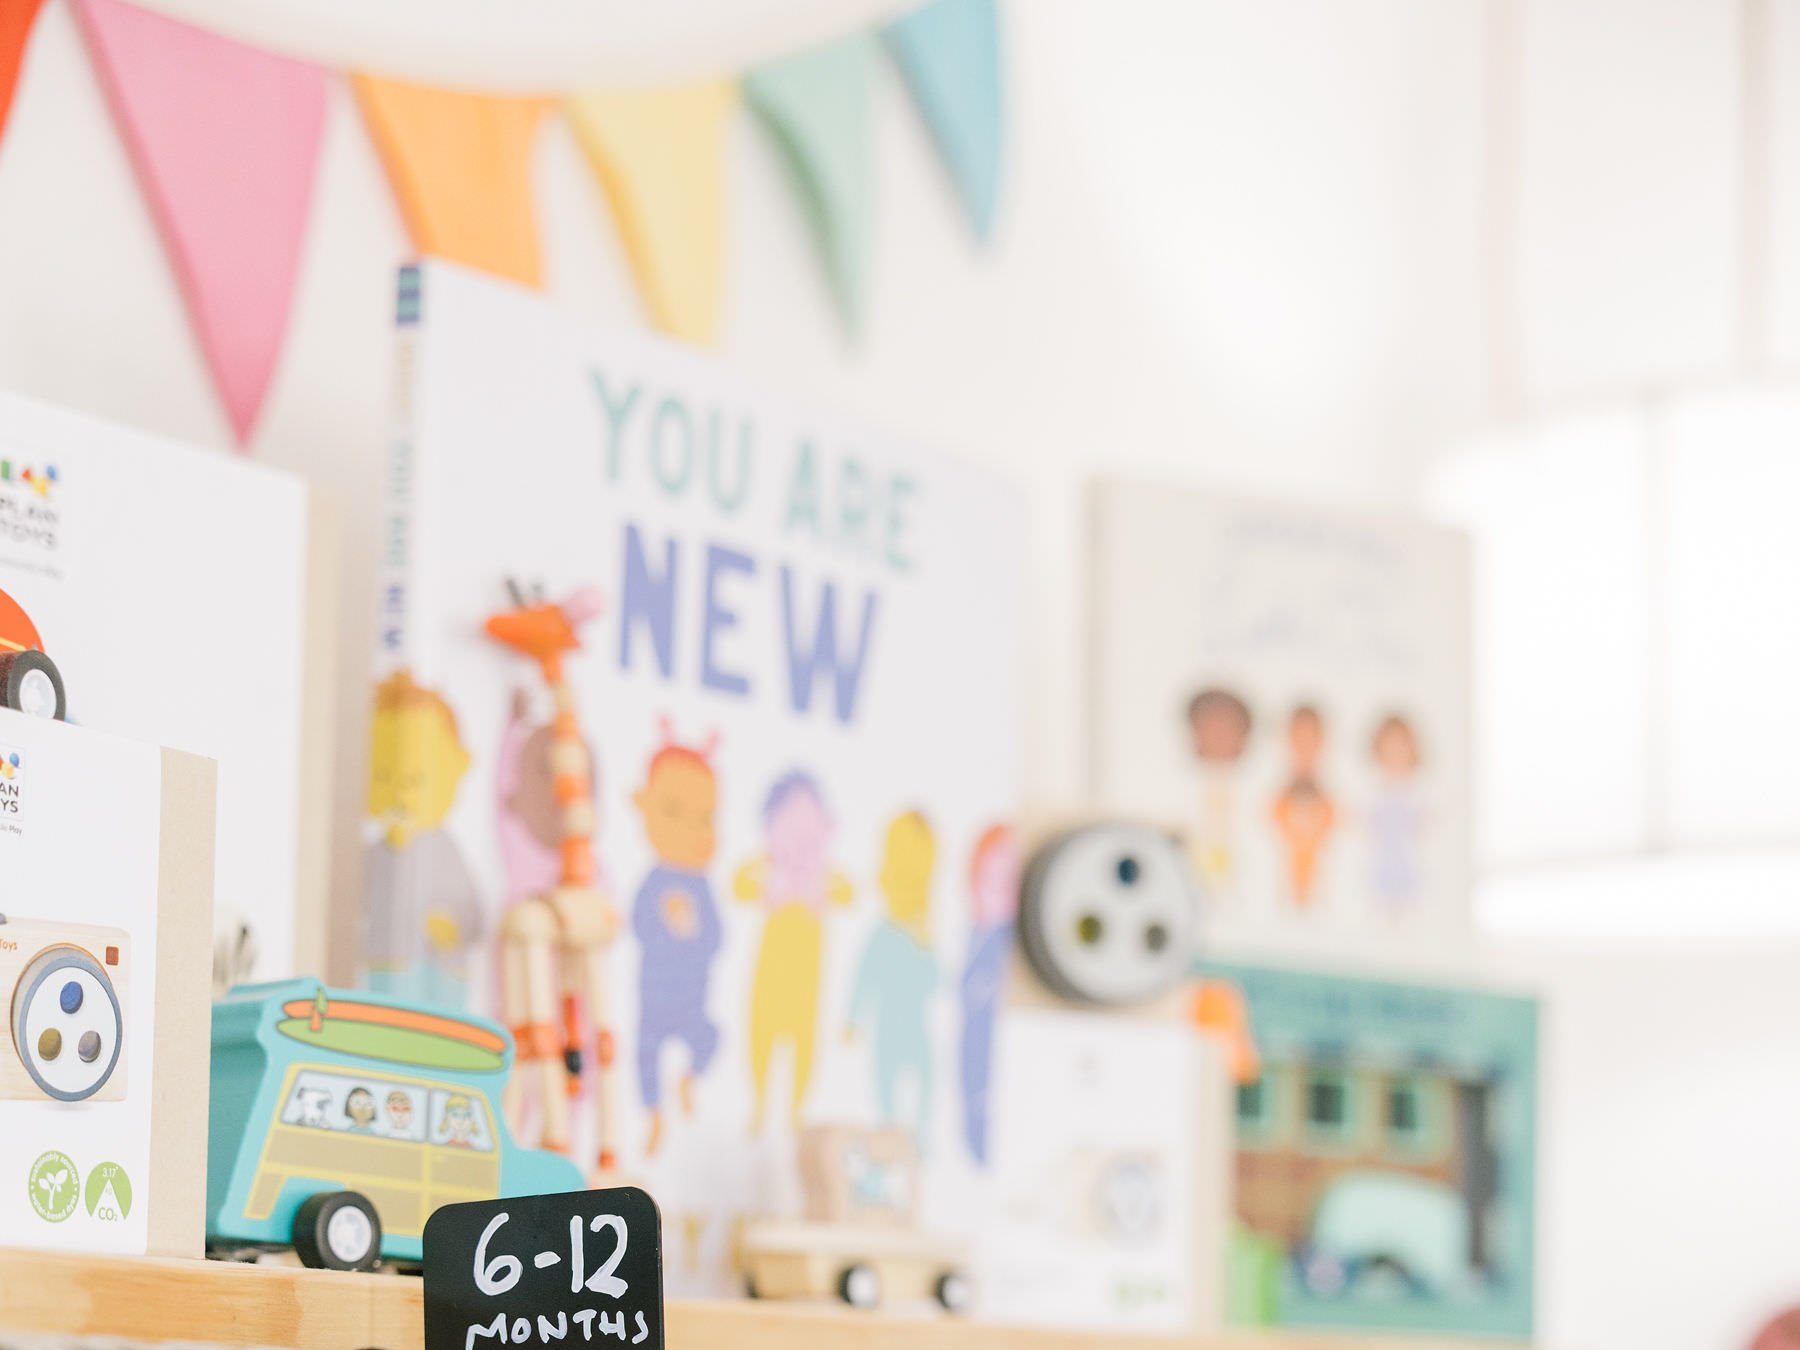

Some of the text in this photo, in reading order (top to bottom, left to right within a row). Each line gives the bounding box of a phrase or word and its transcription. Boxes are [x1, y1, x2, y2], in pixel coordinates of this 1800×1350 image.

[587, 365, 753, 514] YOU
[784, 438, 918, 578] ARE
[618, 522, 880, 724] NEW
[473, 1212, 629, 1299] 6-12
